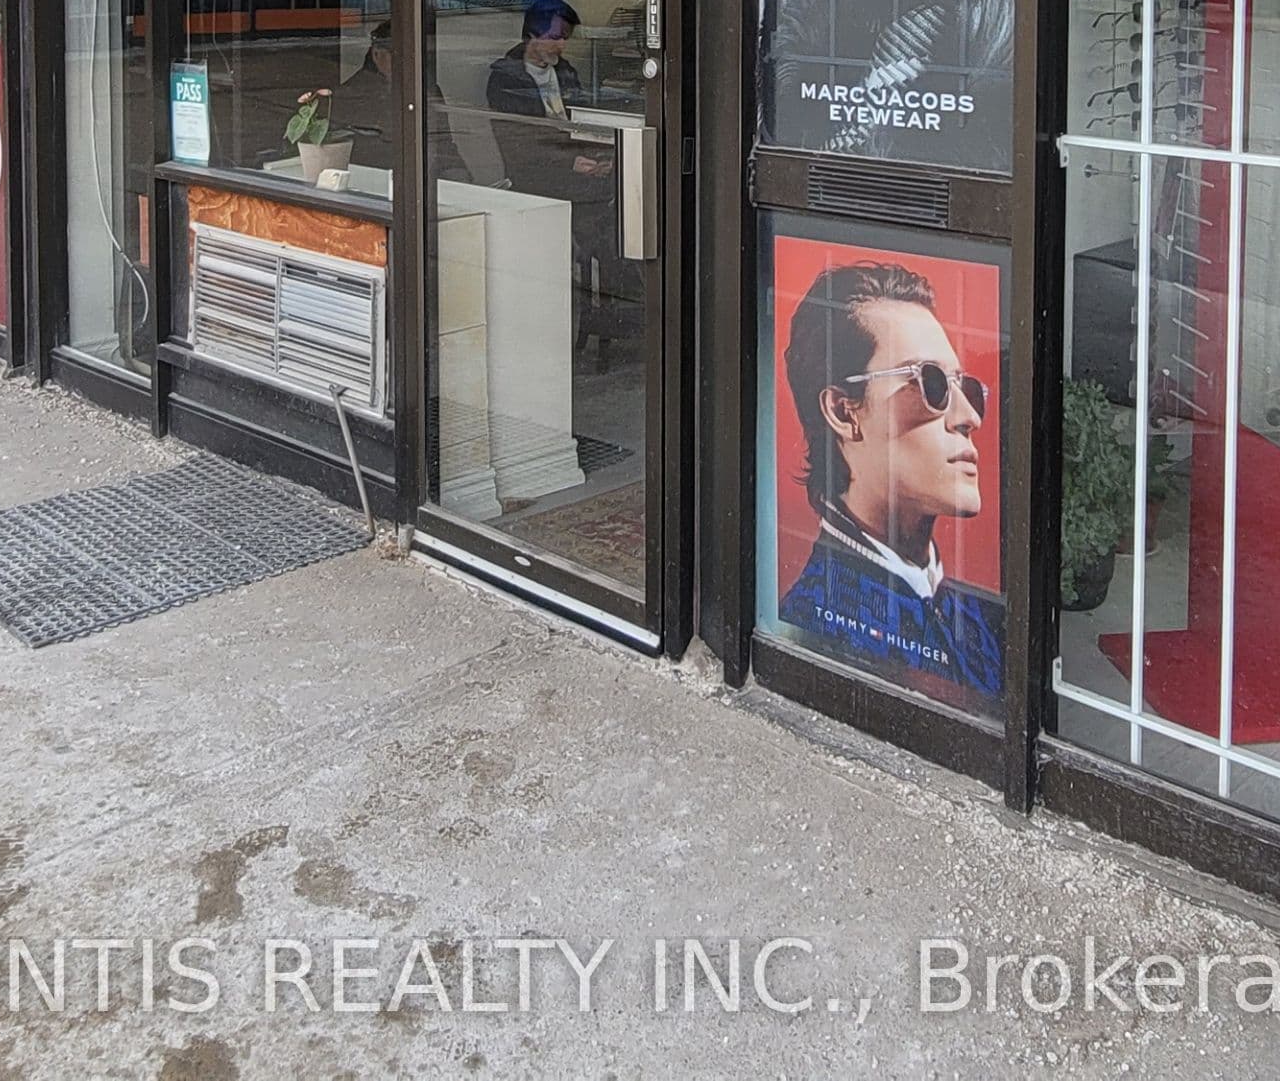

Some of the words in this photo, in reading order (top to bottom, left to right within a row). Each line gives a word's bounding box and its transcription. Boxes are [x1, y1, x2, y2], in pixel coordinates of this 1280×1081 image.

[176, 82, 202, 102] PASS
[800, 83, 865, 104] MARC
[872, 89, 975, 113] JACOBS
[829, 105, 941, 131] EYEWEAR
[816, 607, 867, 633] TOMMY
[887, 633, 950, 665] HILFIGER
